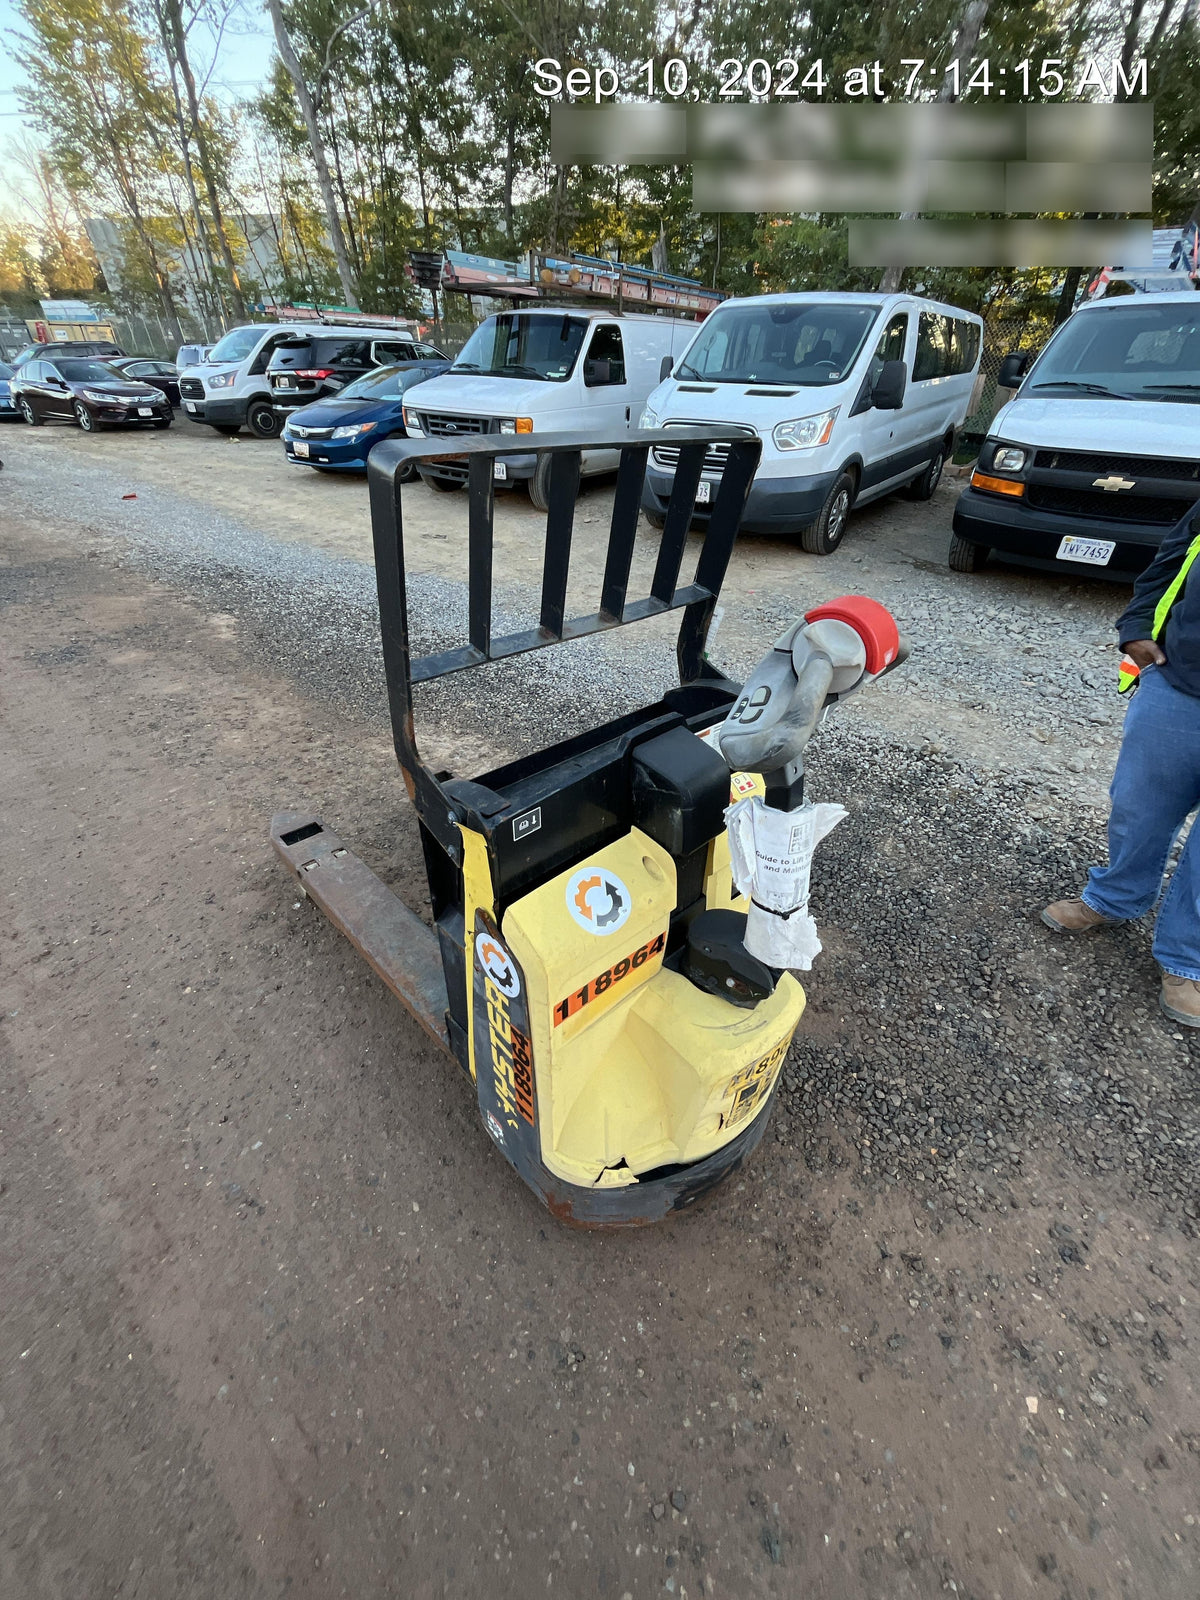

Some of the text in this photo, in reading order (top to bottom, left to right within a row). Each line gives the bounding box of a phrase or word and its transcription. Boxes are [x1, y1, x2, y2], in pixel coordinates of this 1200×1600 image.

[755, 850, 778, 864] Guide
[763, 864, 780, 873] and
[556, 932, 665, 1021] 118964
[484, 976, 519, 1130] HYSTER
[511, 1024, 533, 1121] 118964
